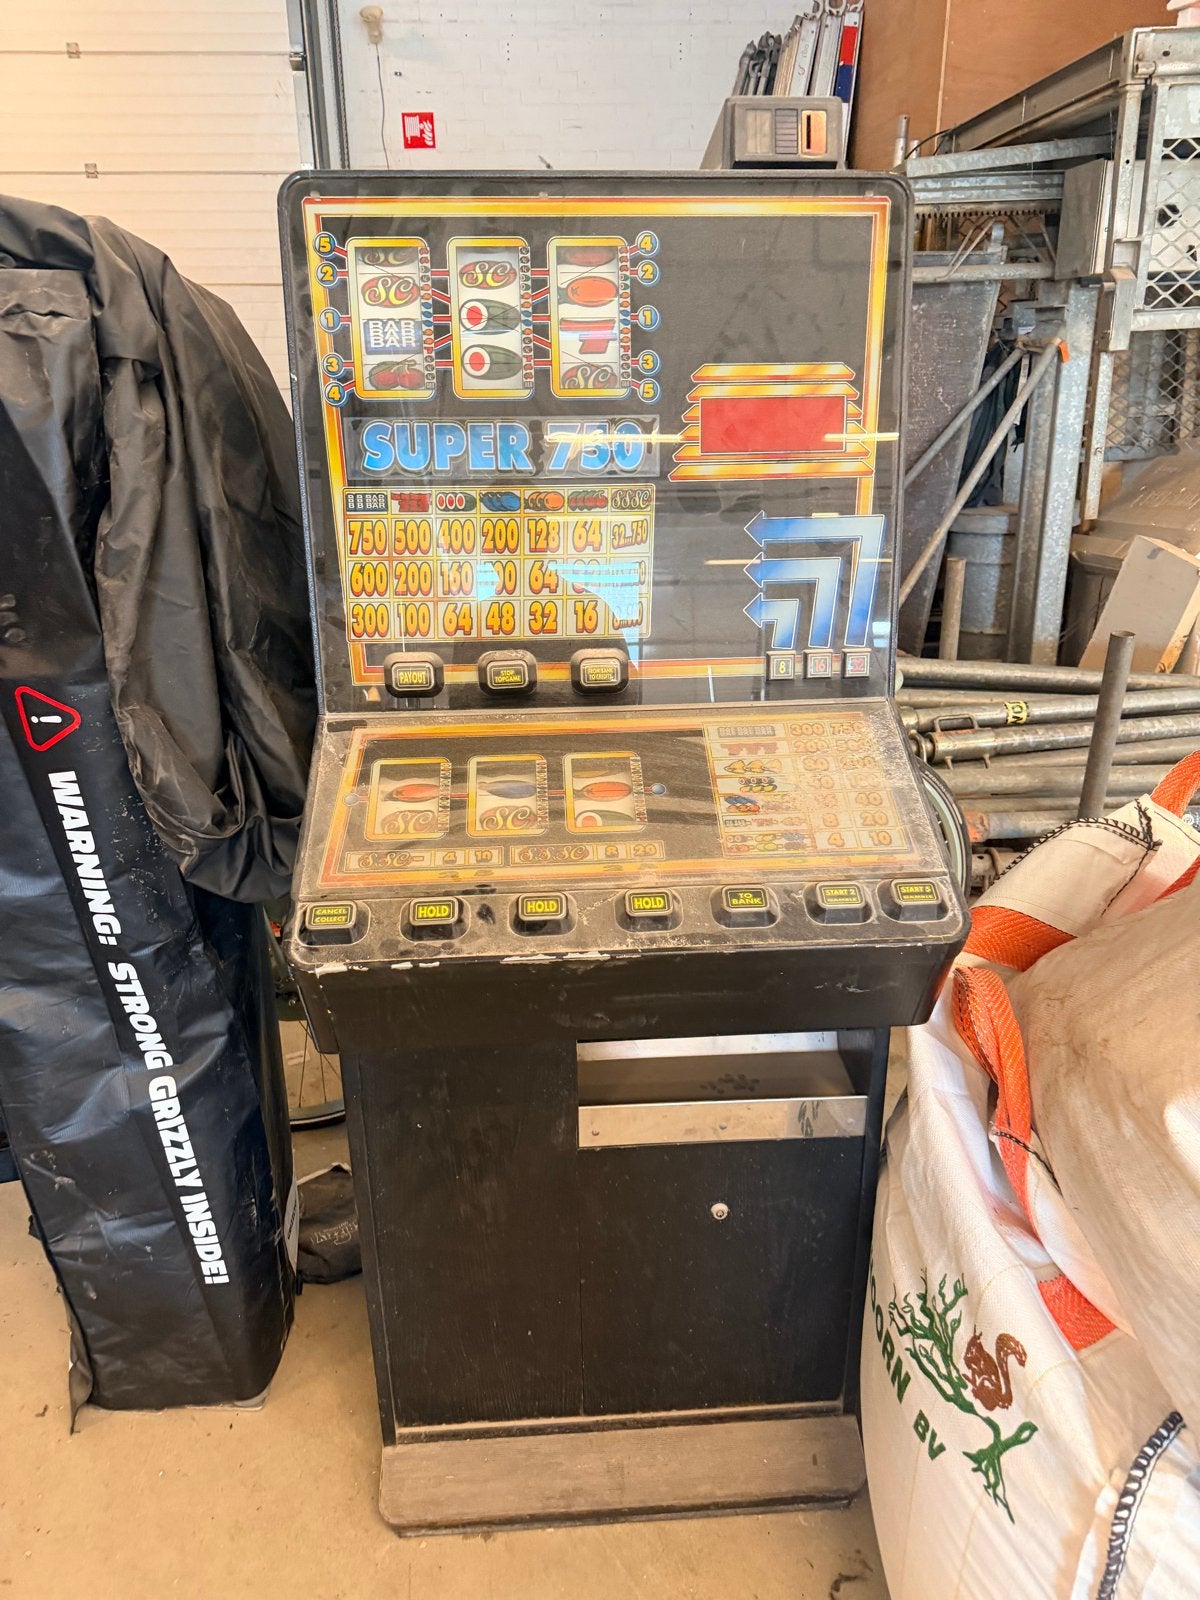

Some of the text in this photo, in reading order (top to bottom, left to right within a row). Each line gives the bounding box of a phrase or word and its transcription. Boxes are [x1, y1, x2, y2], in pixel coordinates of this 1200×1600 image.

[318, 237, 332, 252] 5
[640, 236, 652, 251] 4
[321, 266, 333, 281] 2
[641, 264, 654, 279] 2
[325, 312, 335, 327] 1
[643, 310, 652, 325] 1
[370, 337, 416, 348] BAR
[326, 357, 338, 372] 3
[642, 354, 654, 370] 3
[327, 385, 340, 401] 4
[643, 383, 655, 399] 5
[362, 421, 647, 472] SUPER 750
[349, 519, 387, 555] 750
[394, 519, 433, 555] 500
[439, 518, 475, 555] 400
[482, 518, 520, 554] 200
[528, 518, 560, 553] 128
[573, 518, 602, 552] 64
[350, 560, 388, 597] 600
[394, 560, 433, 596] 200
[441, 559, 473, 596] 160
[483, 560, 517, 595] 00
[529, 559, 559, 595] 64
[351, 603, 389, 637] 300
[397, 602, 430, 637] 100
[443, 602, 473, 636] 64
[486, 601, 515, 635] 48
[528, 600, 559, 635] 32
[574, 600, 599, 634] 16
[779, 661, 786, 673] 8
[814, 659, 826, 672] 16
[851, 658, 865, 672] 32
[399, 672, 426, 684] PAYOUT
[790, 723, 825, 736] 300
[794, 740, 829, 753] 200
[803, 757, 829, 771] 80
[855, 792, 883, 806] 40
[860, 809, 889, 827] 20
[828, 830, 892, 847] 4 10
[527, 900, 557, 914] HOLD
[634, 896, 664, 910] HOLD
[418, 905, 449, 919] HOLD
[47, 769, 230, 1286] WARNING: STRONG GRIZZLY INSIDE!
[870, 1259, 947, 1462] OORN BV
